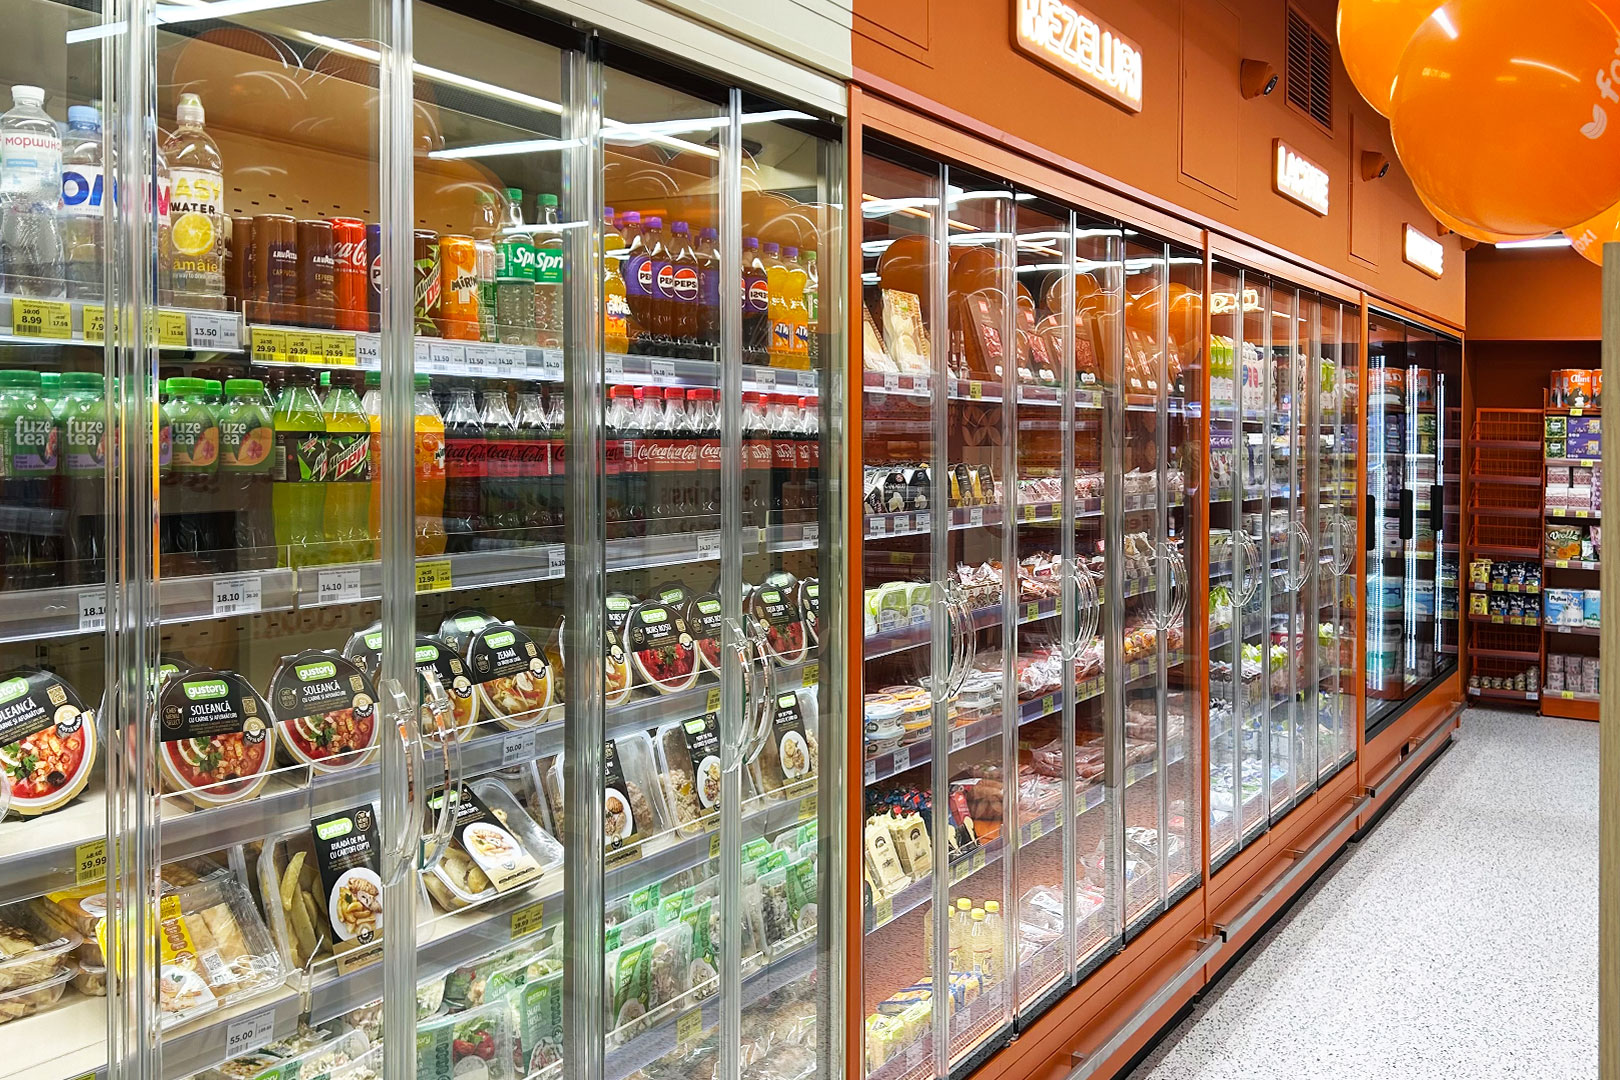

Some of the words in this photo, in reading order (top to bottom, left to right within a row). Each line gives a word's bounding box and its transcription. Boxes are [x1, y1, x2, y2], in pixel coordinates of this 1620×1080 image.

[171, 176, 222, 202] ASY
[171, 202, 216, 215] WATER
[21, 315, 42, 325] 8.99
[195, 327, 217, 337] 13.50
[256, 344, 276, 353] 29.99
[289, 347, 308, 355] 29.99
[326, 349, 343, 357] 29.99
[359, 347, 377, 356] 11.45
[469, 357, 484, 365] 11.50
[15, 415, 51, 433] fuze
[66, 415, 103, 434] fuze
[15, 432, 45, 446] tea
[66, 432, 96, 446] tea
[221, 433, 240, 445] ea
[321, 583, 342, 592] 14.10
[216, 592, 239, 603] 18.10
[487, 633, 515, 647] gustory
[299, 665, 335, 680] gustory
[188, 684, 226, 698] gustory
[302, 679, 341, 696] SOLEANCĂ
[190, 700, 232, 716] SOLEANCĂ
[320, 822, 351, 838] gustory
[81, 856, 107, 870] 39.99
[229, 1030, 253, 1045] 55.00
